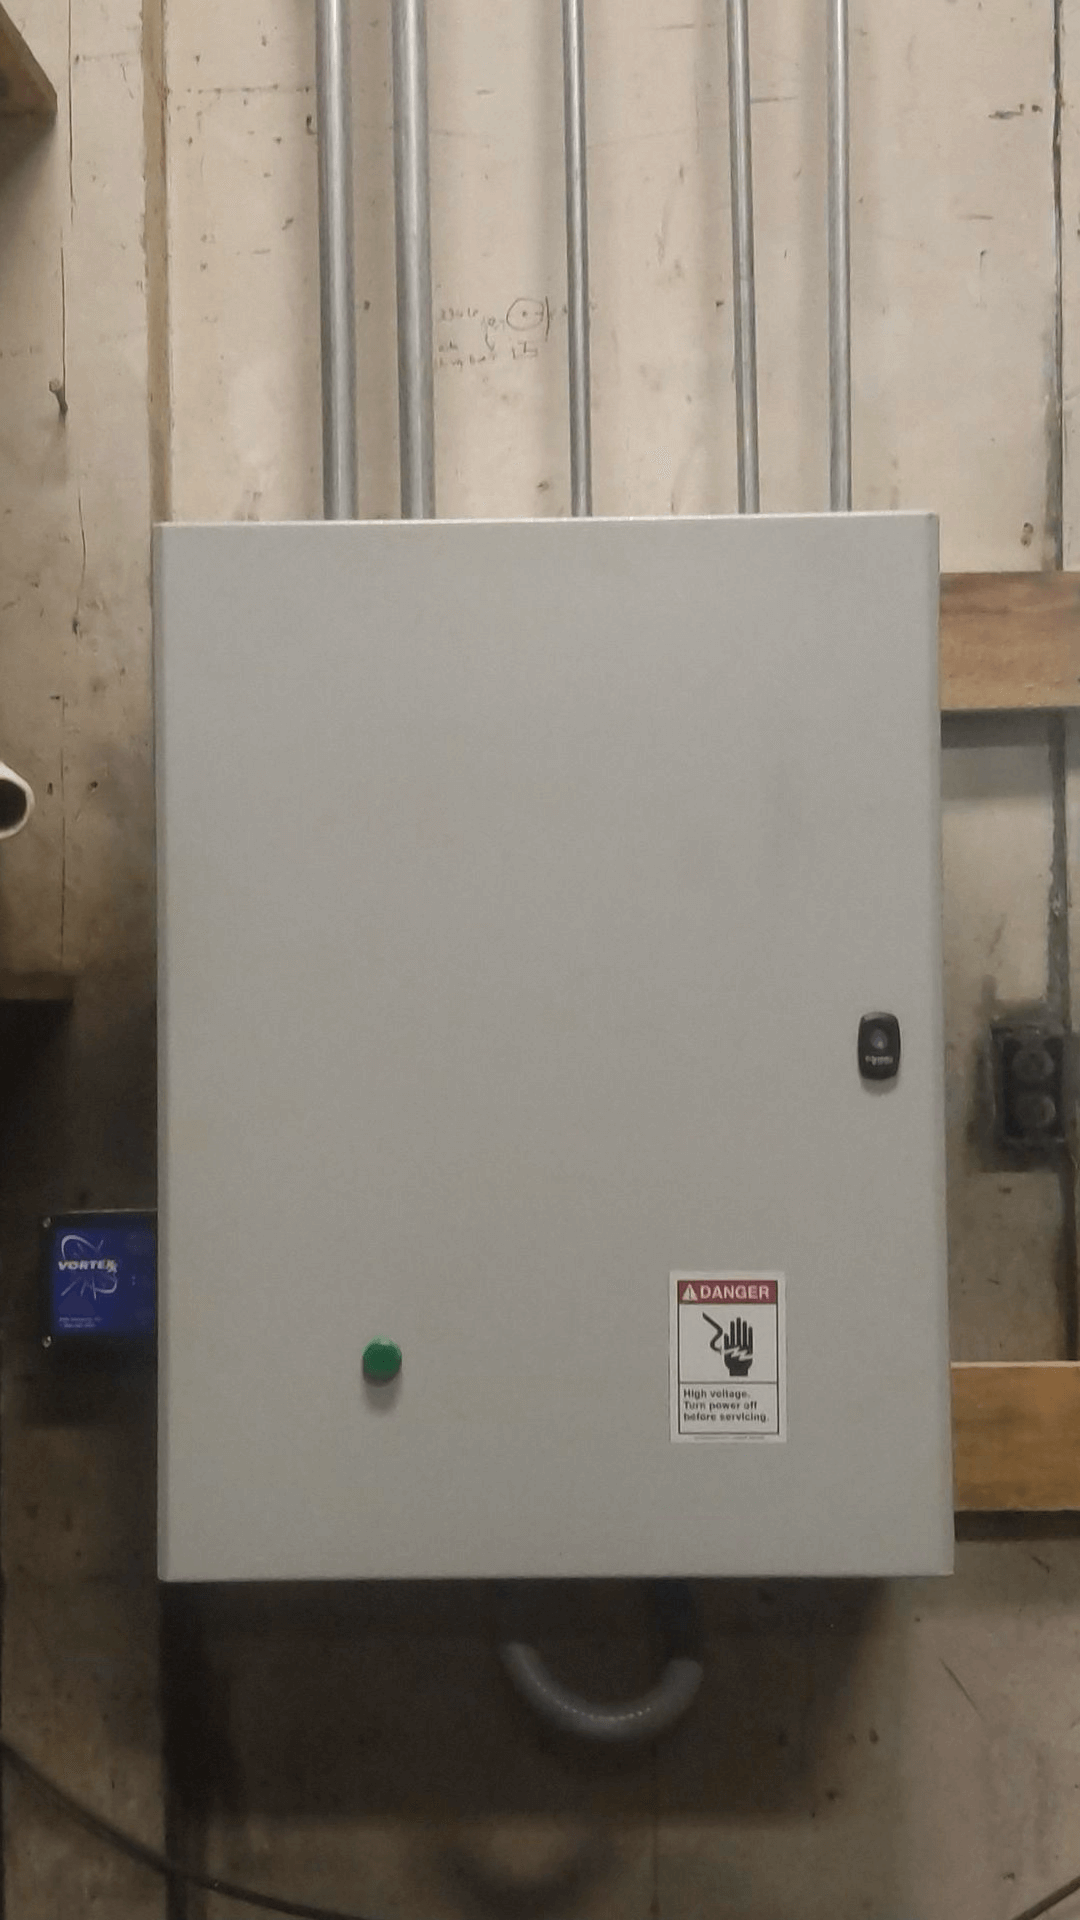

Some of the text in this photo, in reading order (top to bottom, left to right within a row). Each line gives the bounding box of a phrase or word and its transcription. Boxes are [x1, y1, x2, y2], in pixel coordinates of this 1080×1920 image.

[701, 1285, 770, 1300] DANGER
[684, 1389, 707, 1400] High
[684, 1401, 757, 1412] Turn power off
[684, 1413, 769, 1423] before servicing.
